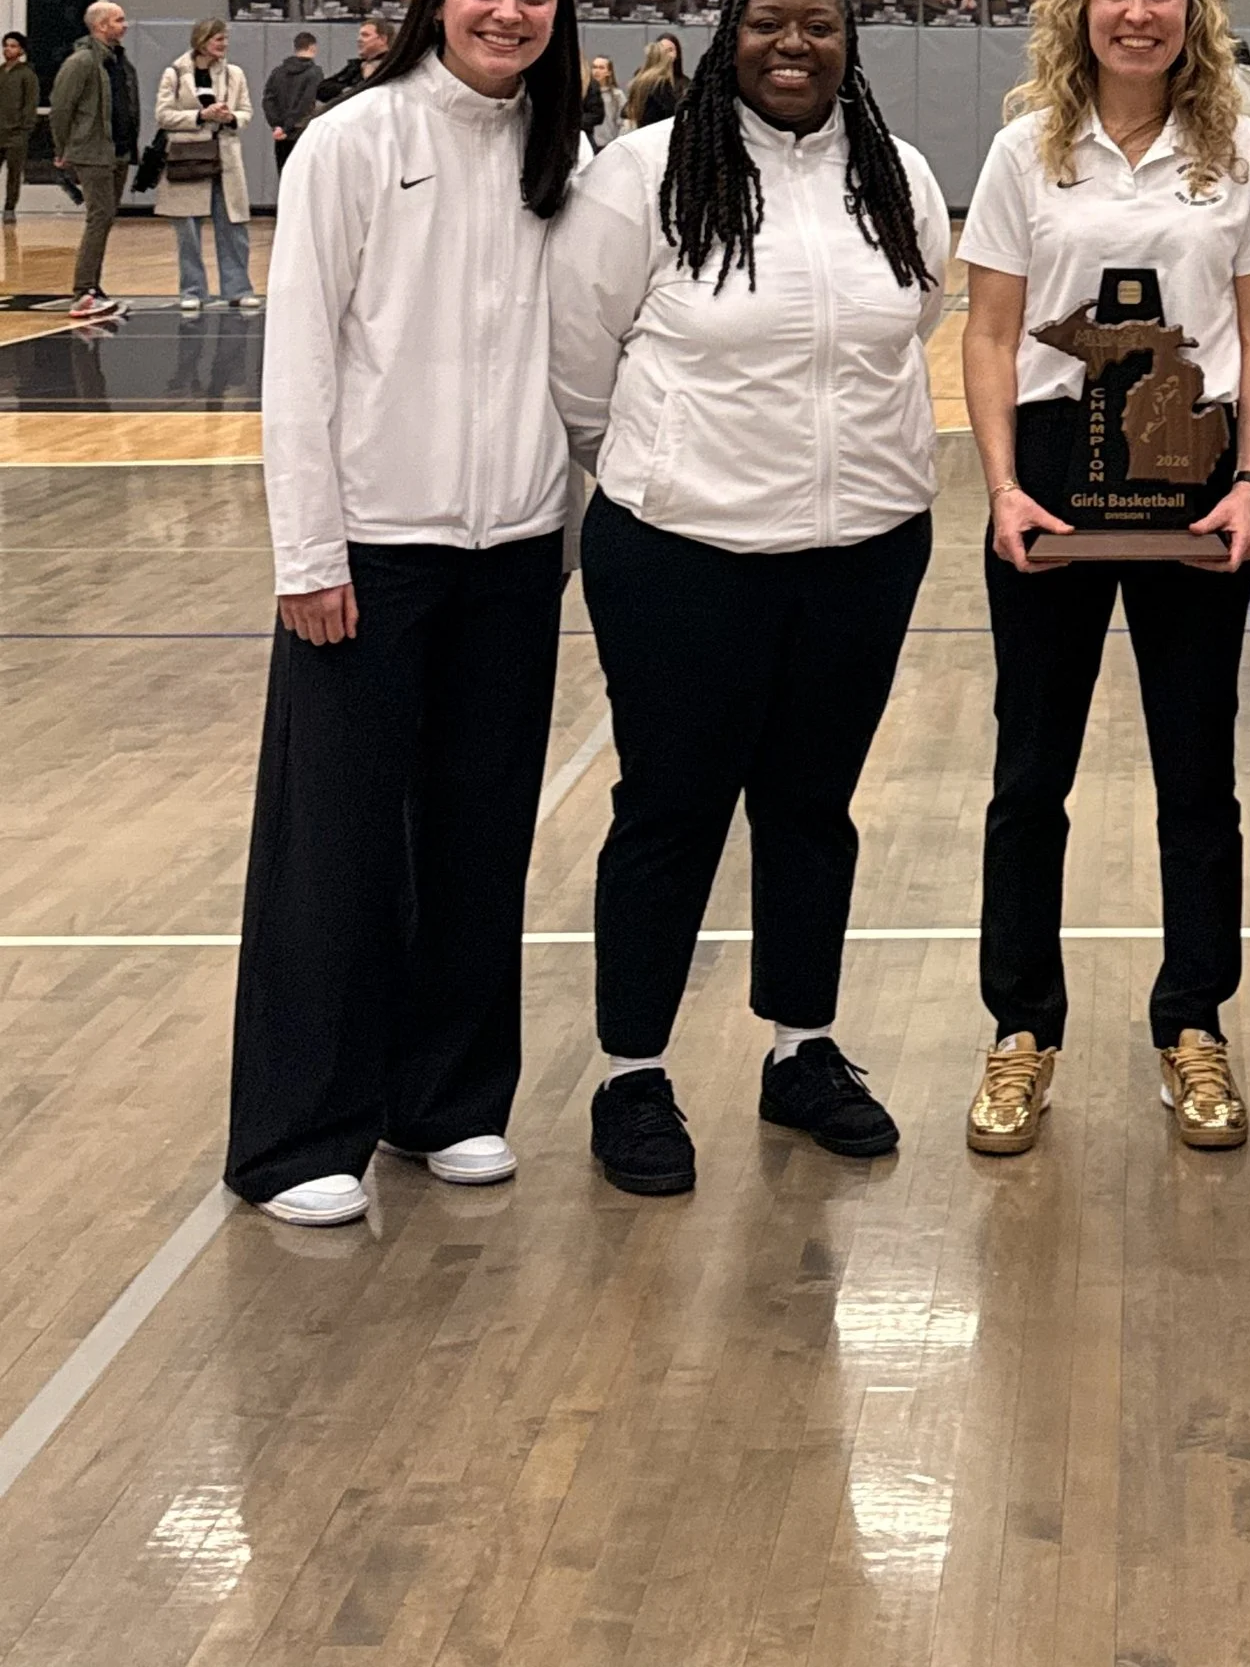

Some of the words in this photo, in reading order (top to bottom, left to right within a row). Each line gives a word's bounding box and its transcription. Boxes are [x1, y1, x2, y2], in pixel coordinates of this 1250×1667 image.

[1089, 387, 1106, 482] CHAMPION
[1155, 455, 1190, 467] 2026
[1070, 492, 1106, 508] Girls
[1108, 492, 1185, 508] Basketball
[1104, 512, 1144, 520] DIVISION
